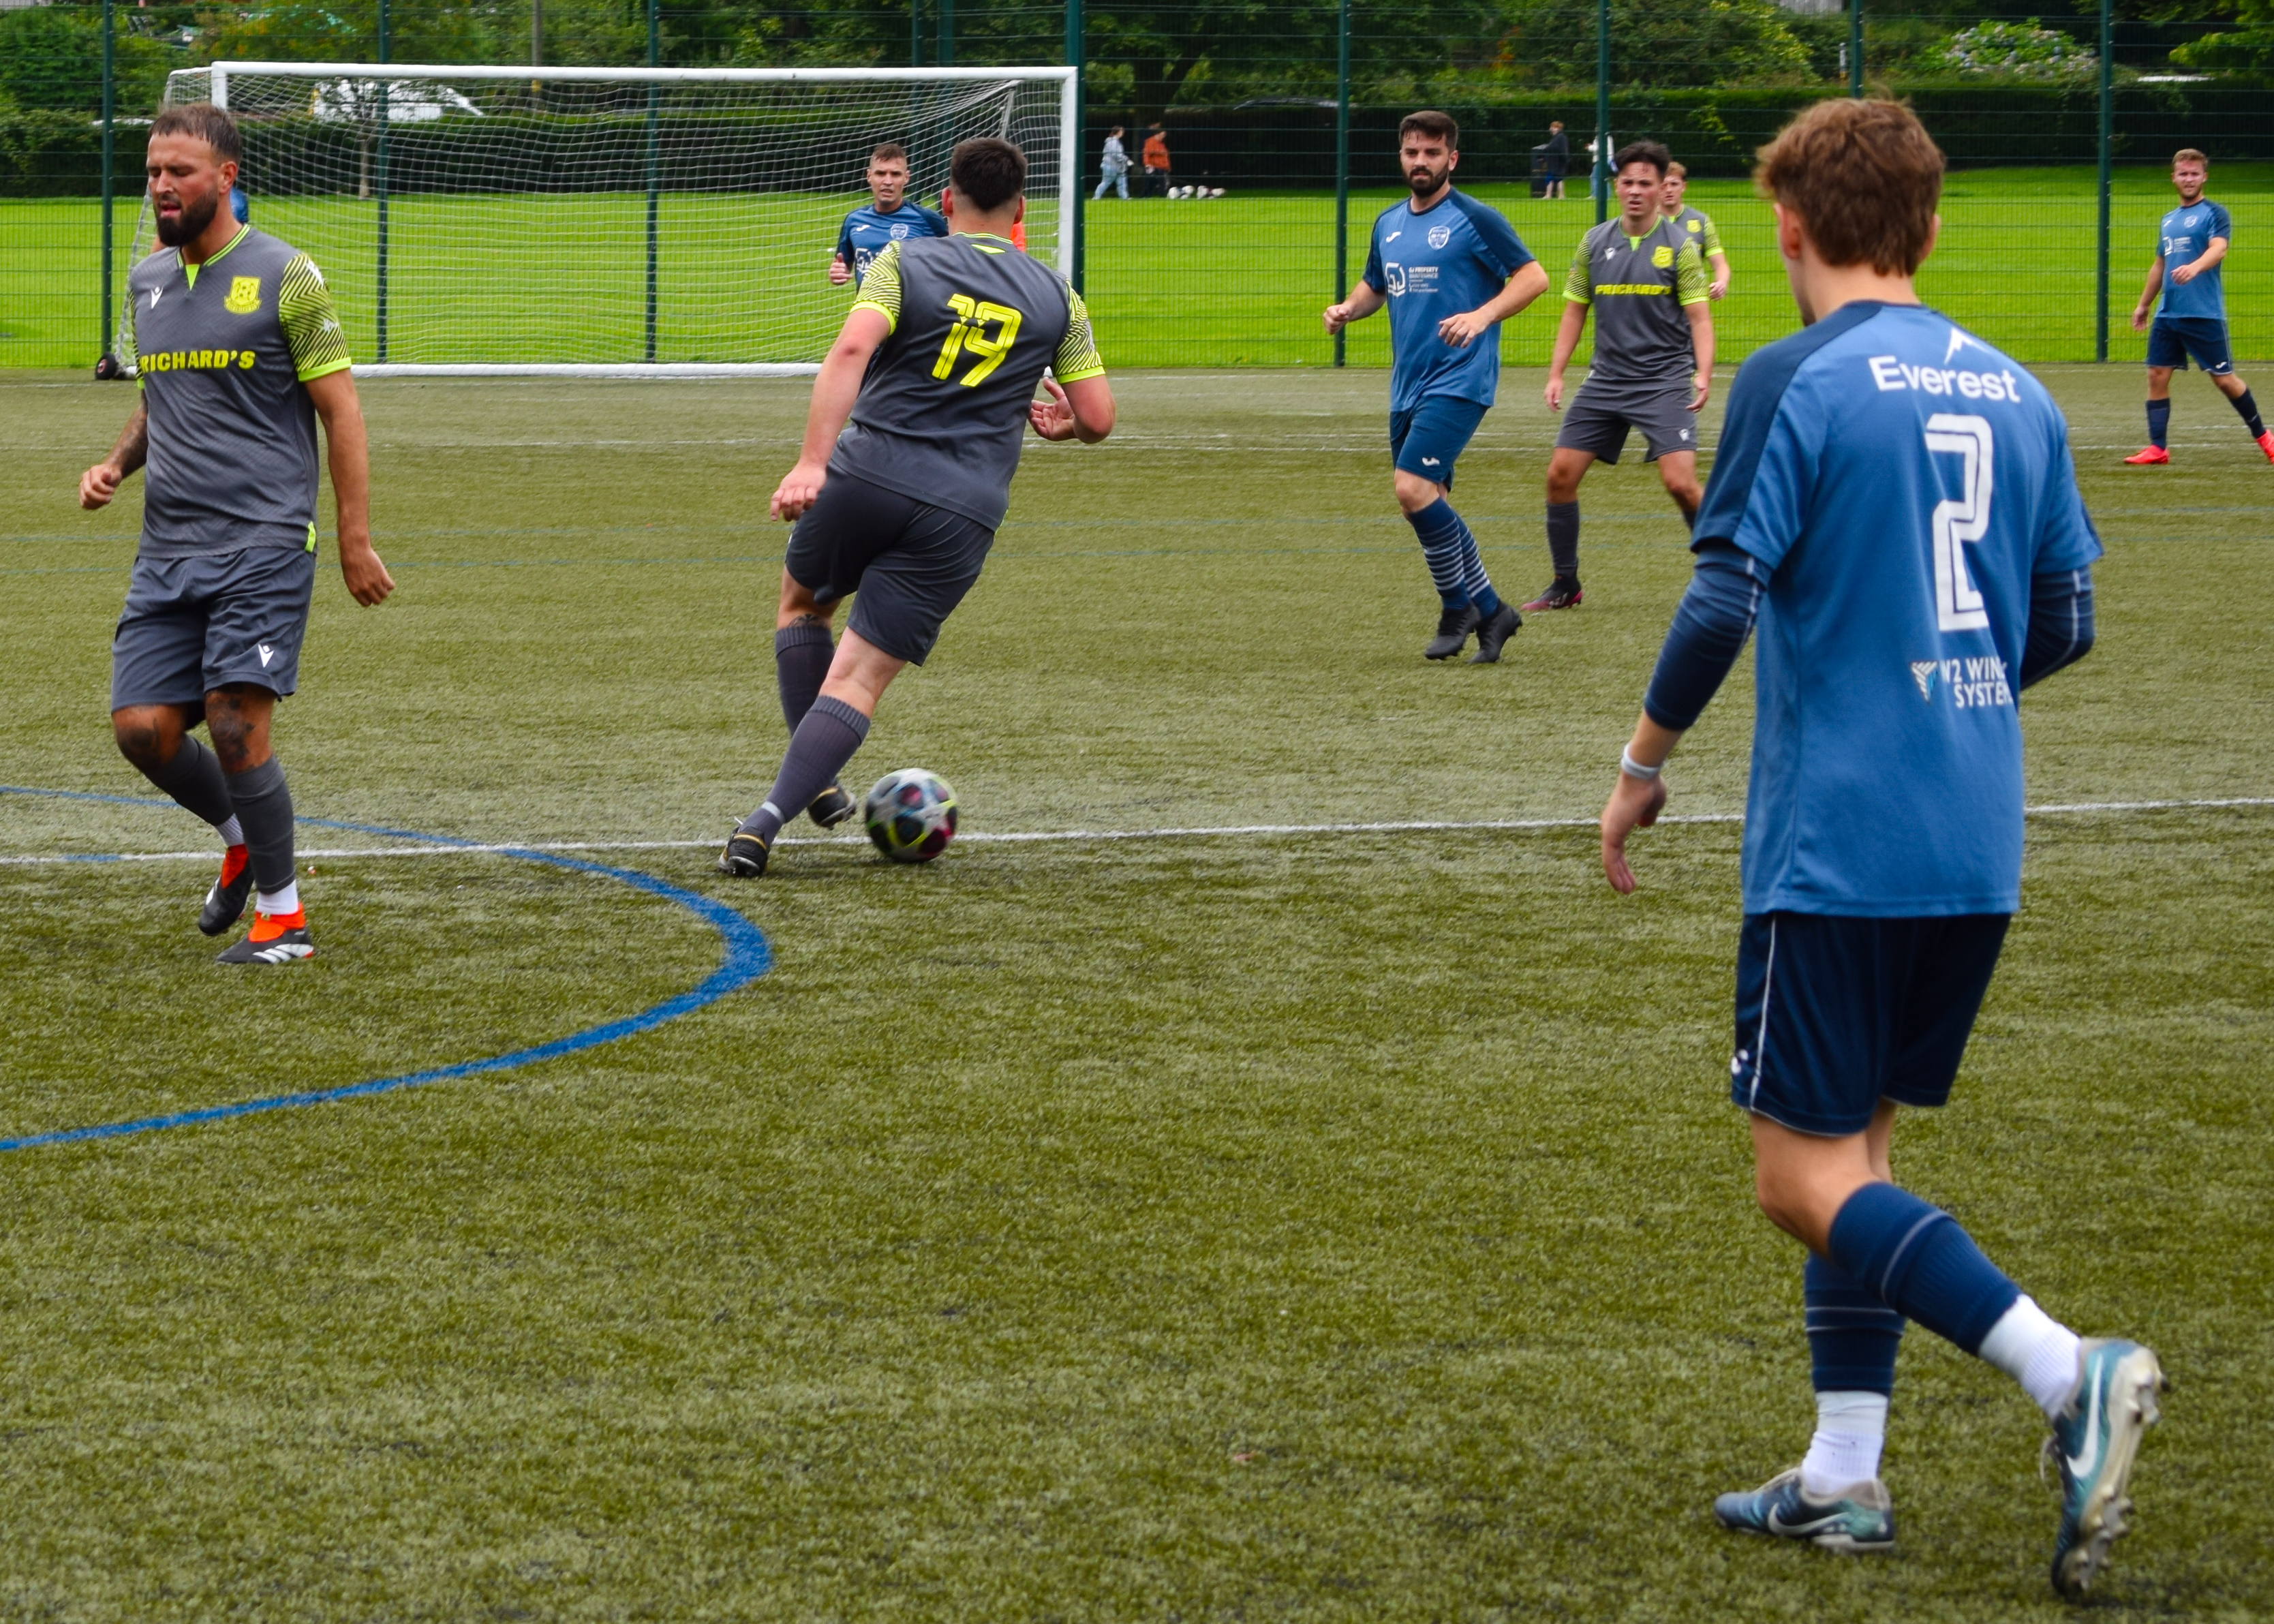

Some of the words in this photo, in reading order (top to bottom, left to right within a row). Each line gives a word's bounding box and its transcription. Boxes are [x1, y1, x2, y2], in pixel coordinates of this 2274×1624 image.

[139, 350, 256, 373] RICHARD'S
[932, 293, 1021, 387] 19
[1868, 355, 2021, 403] Everest
[1924, 413, 1993, 631] 2
[1965, 656, 2008, 681] WIN
